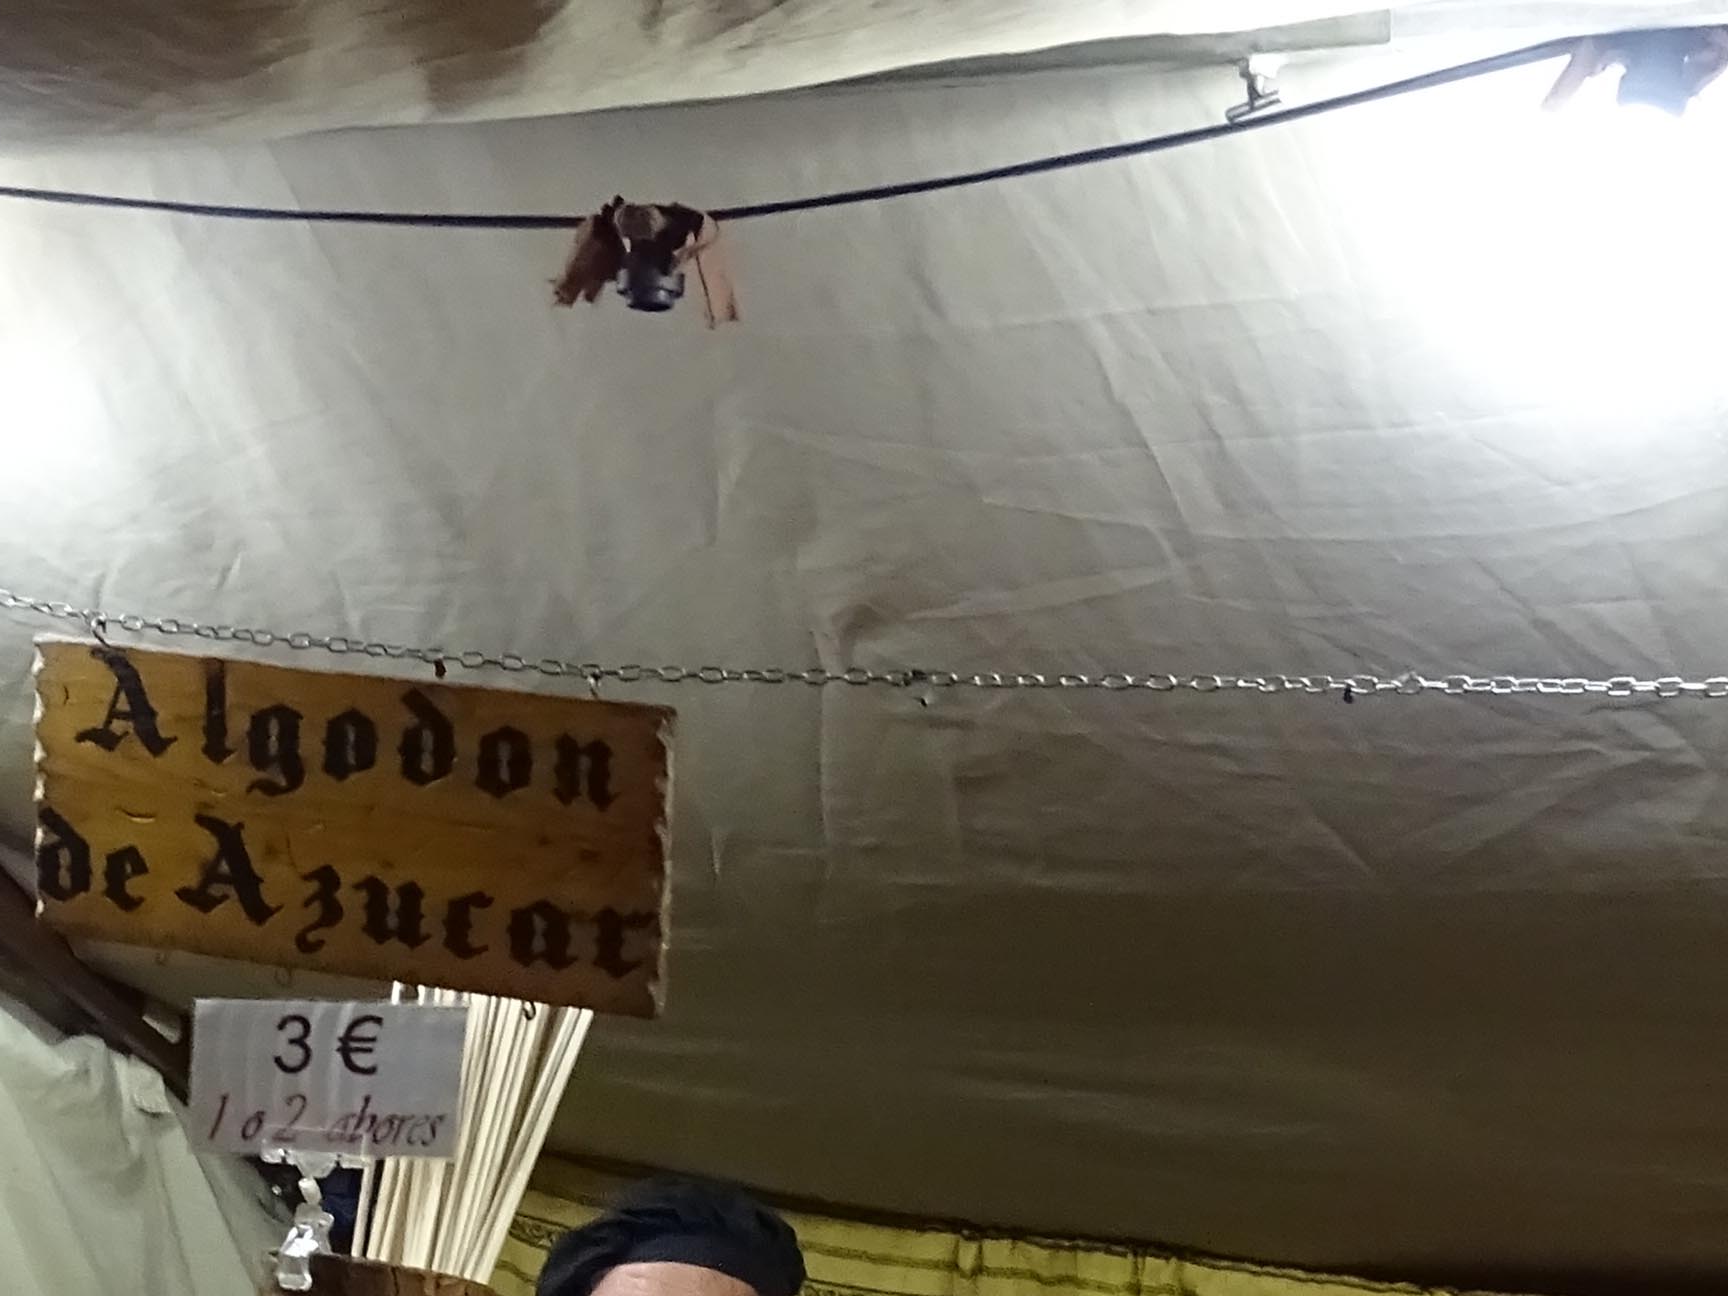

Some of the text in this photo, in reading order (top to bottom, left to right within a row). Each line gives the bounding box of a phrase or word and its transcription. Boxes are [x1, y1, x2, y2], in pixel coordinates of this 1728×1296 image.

[76, 645, 619, 812] Algodon
[38, 807, 660, 979] de Azucar
[274, 1013, 384, 1076] 3 €
[272, 1093, 309, 1143] 2
